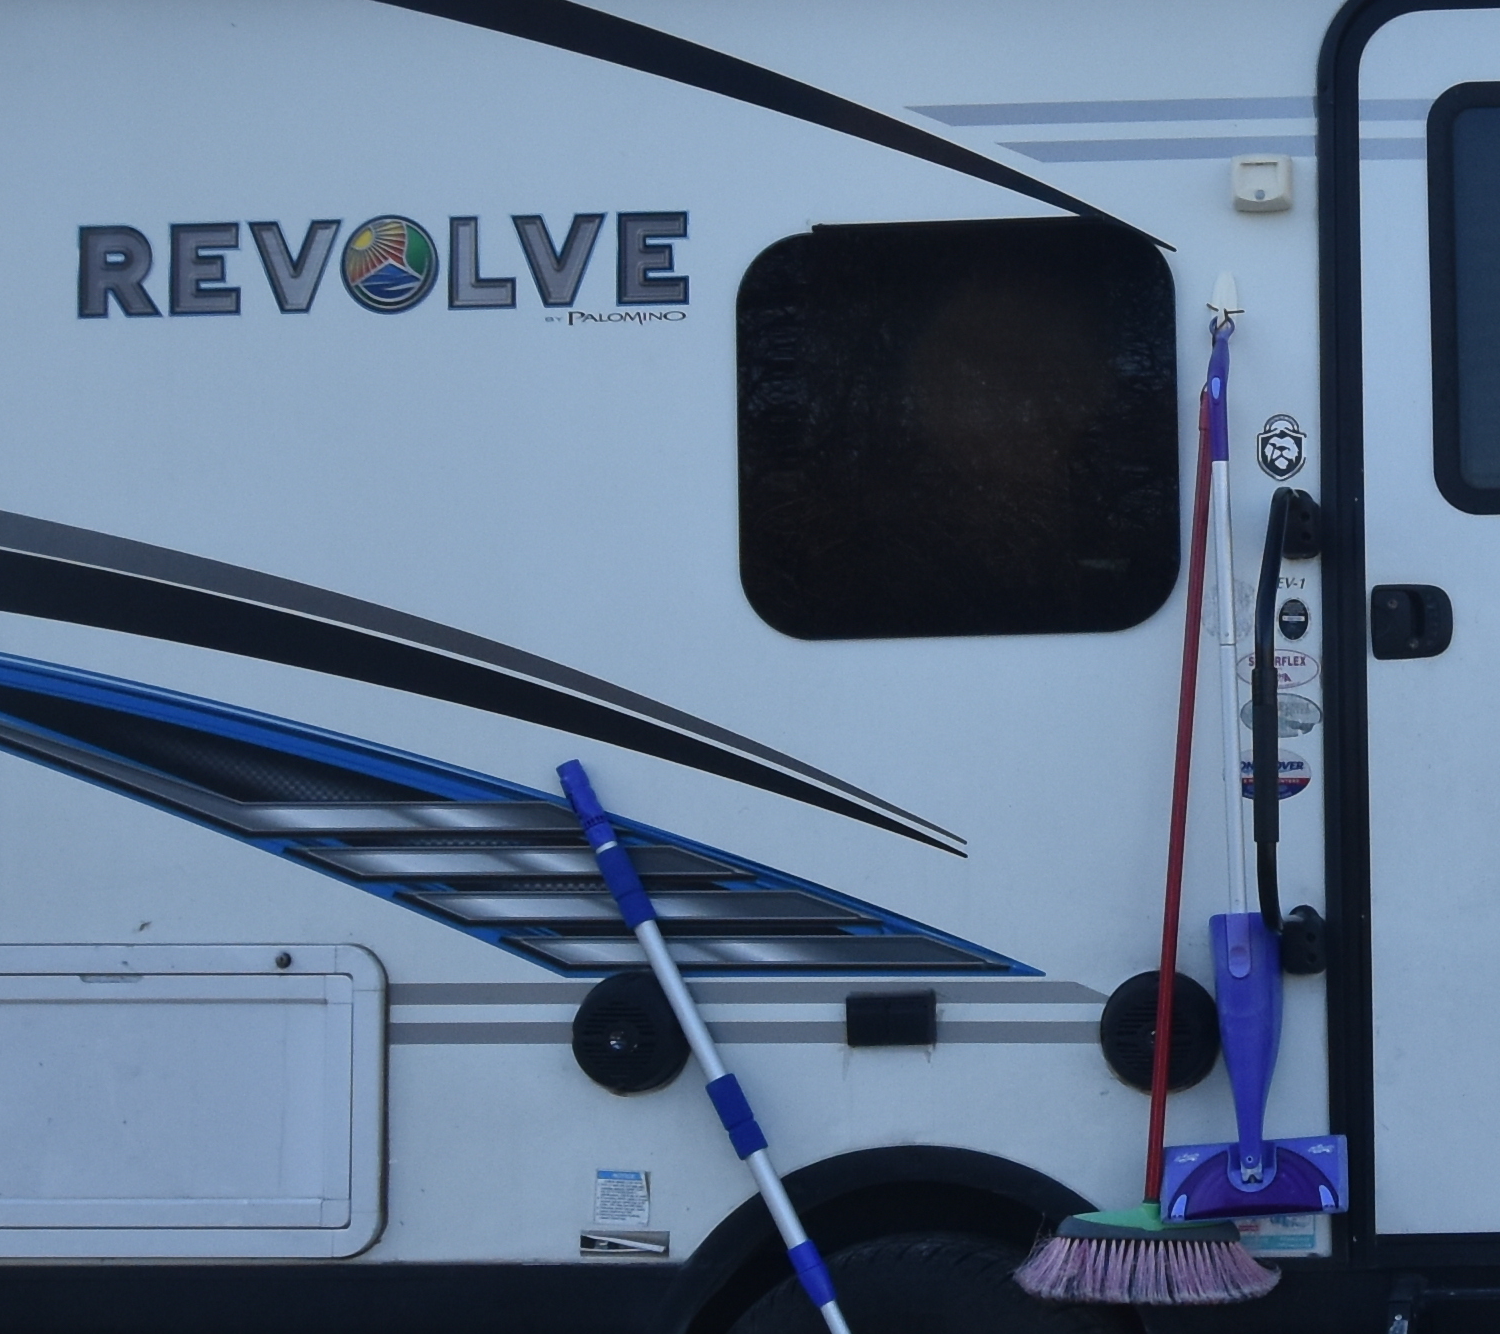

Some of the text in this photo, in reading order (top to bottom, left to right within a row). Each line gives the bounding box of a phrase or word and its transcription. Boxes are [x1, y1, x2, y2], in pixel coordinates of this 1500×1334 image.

[77, 211, 690, 318] REVOLVE
[568, 310, 687, 326] PALOMINO
[1248, 656, 1306, 667] SRFLEX
